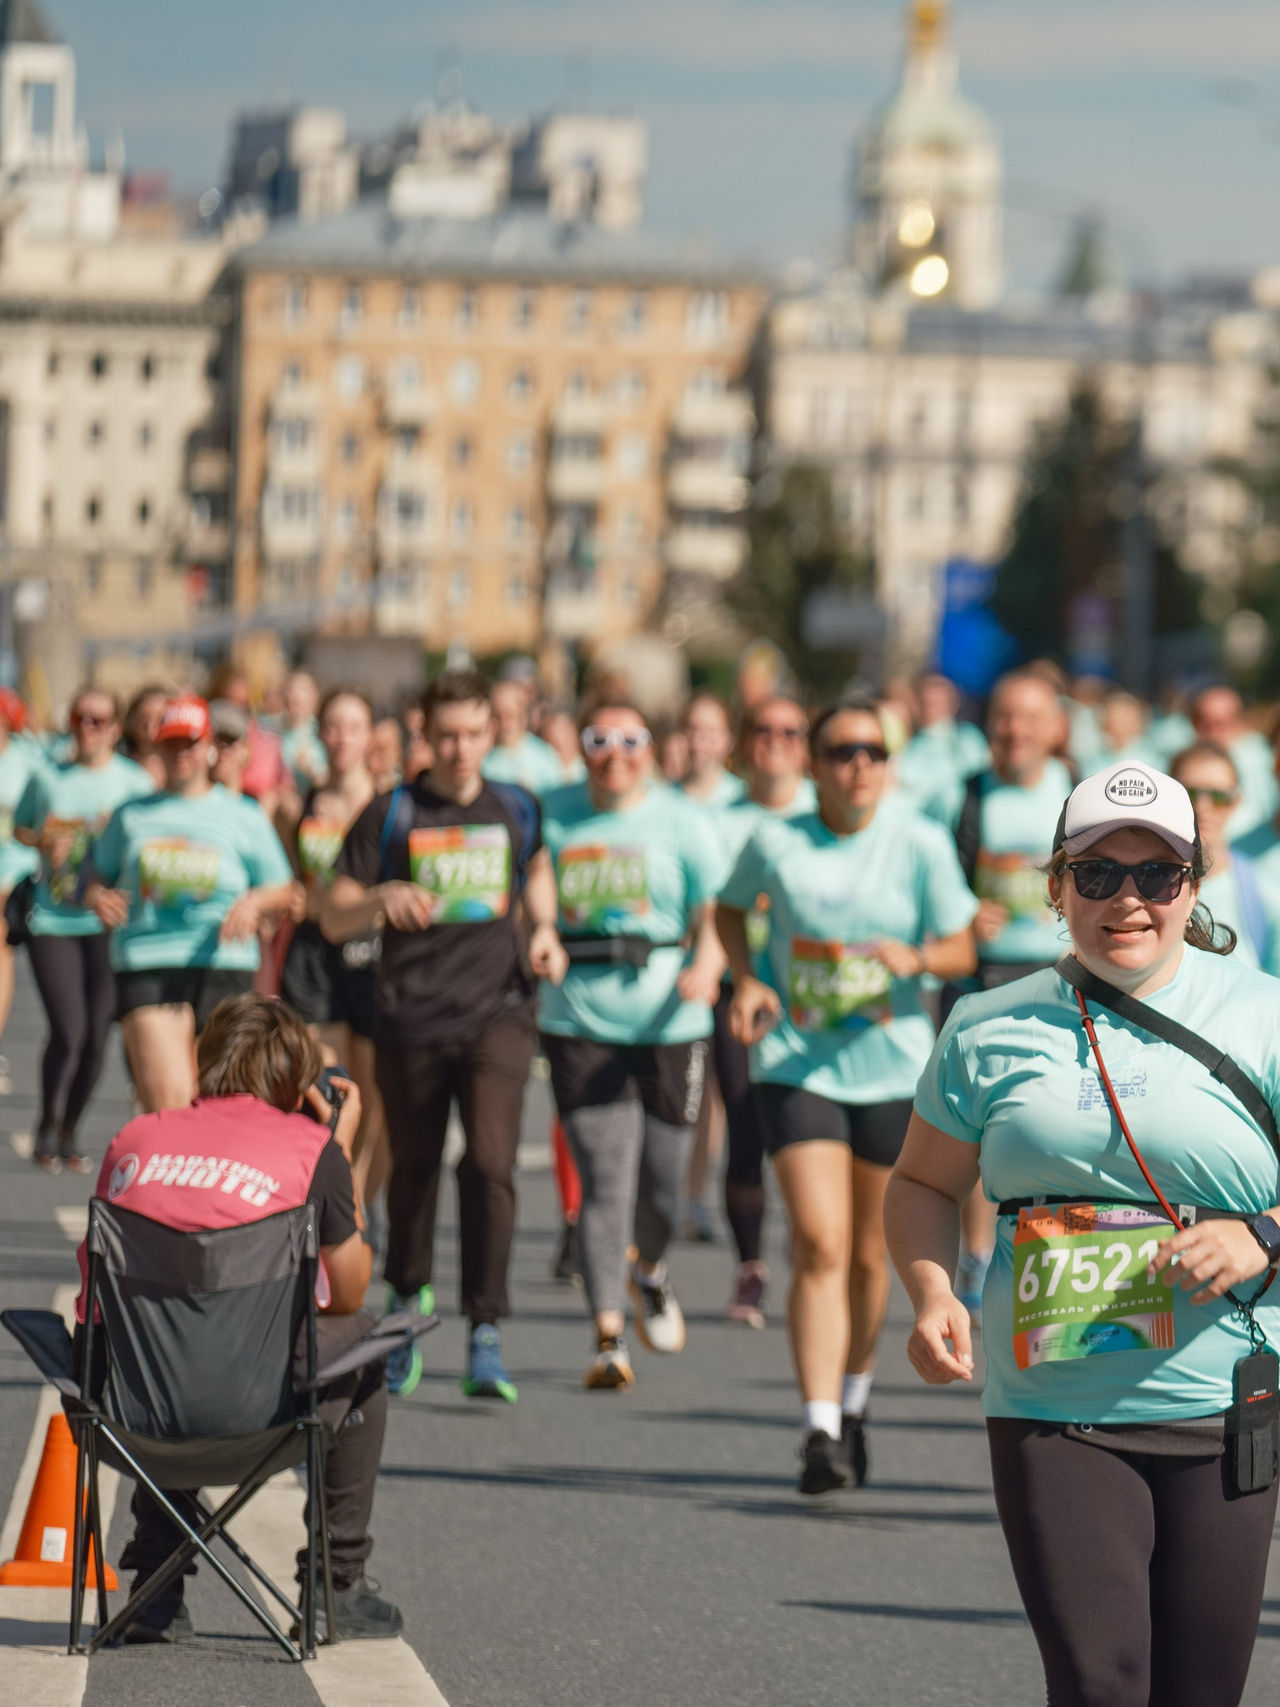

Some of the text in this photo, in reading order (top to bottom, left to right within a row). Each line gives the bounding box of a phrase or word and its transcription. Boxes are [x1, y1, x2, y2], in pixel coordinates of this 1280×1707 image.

[1128, 789, 1144, 797] GAIN
[1080, 1072, 1147, 1088] БОЬШОЙ
[137, 1164, 271, 1207] PHOTO
[148, 1153, 281, 1194] MARATHON
[1018, 1239, 1159, 1303] 67521
[1018, 1295, 1163, 1324] ФЕСТИВАЛЬ ДВИЖЕНИЯ
